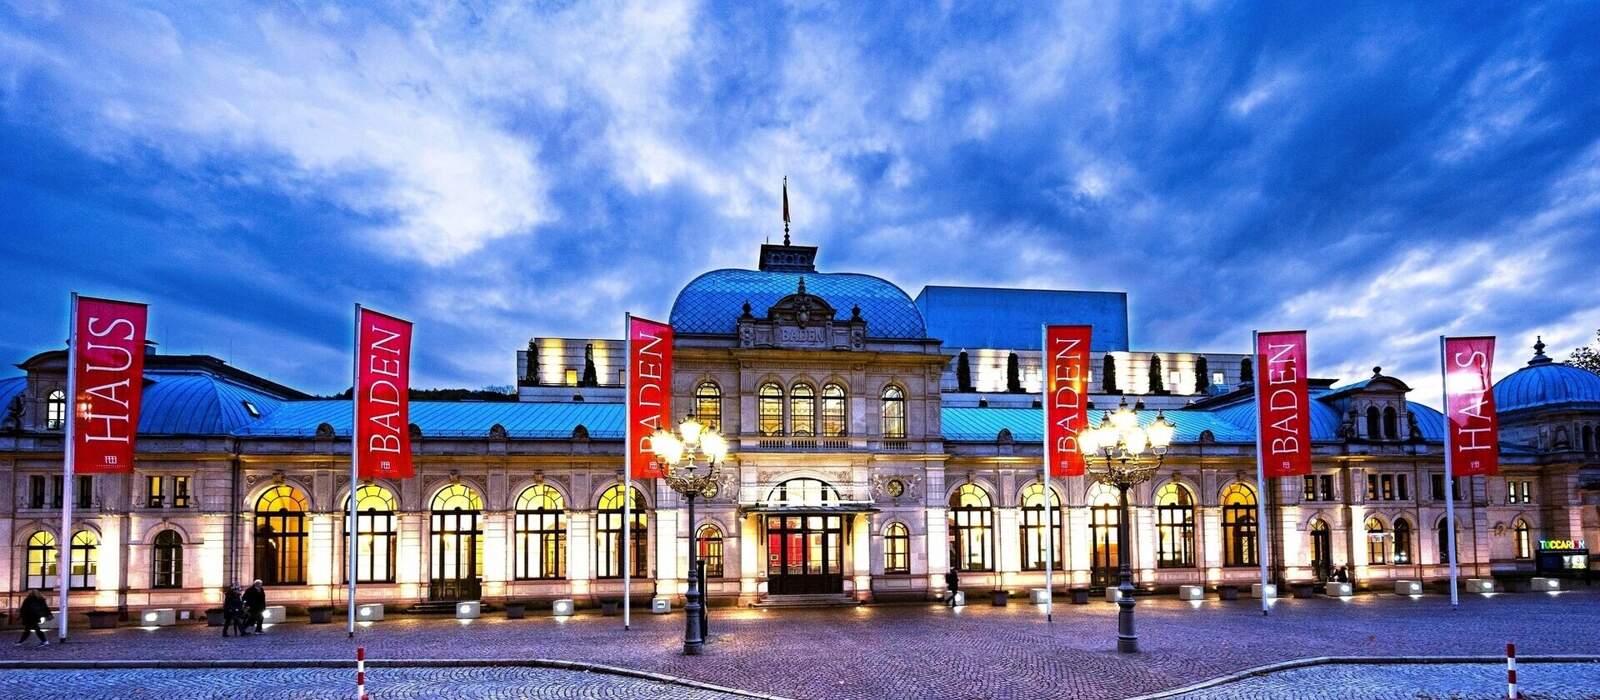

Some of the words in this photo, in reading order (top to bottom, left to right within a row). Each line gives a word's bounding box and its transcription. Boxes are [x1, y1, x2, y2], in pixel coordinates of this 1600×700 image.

[84, 317, 135, 444] HAUS
[370, 325, 401, 454] BADEN
[782, 327, 825, 340] BADEN
[1055, 337, 1081, 453] BADEN
[1268, 343, 1299, 454] BADEN
